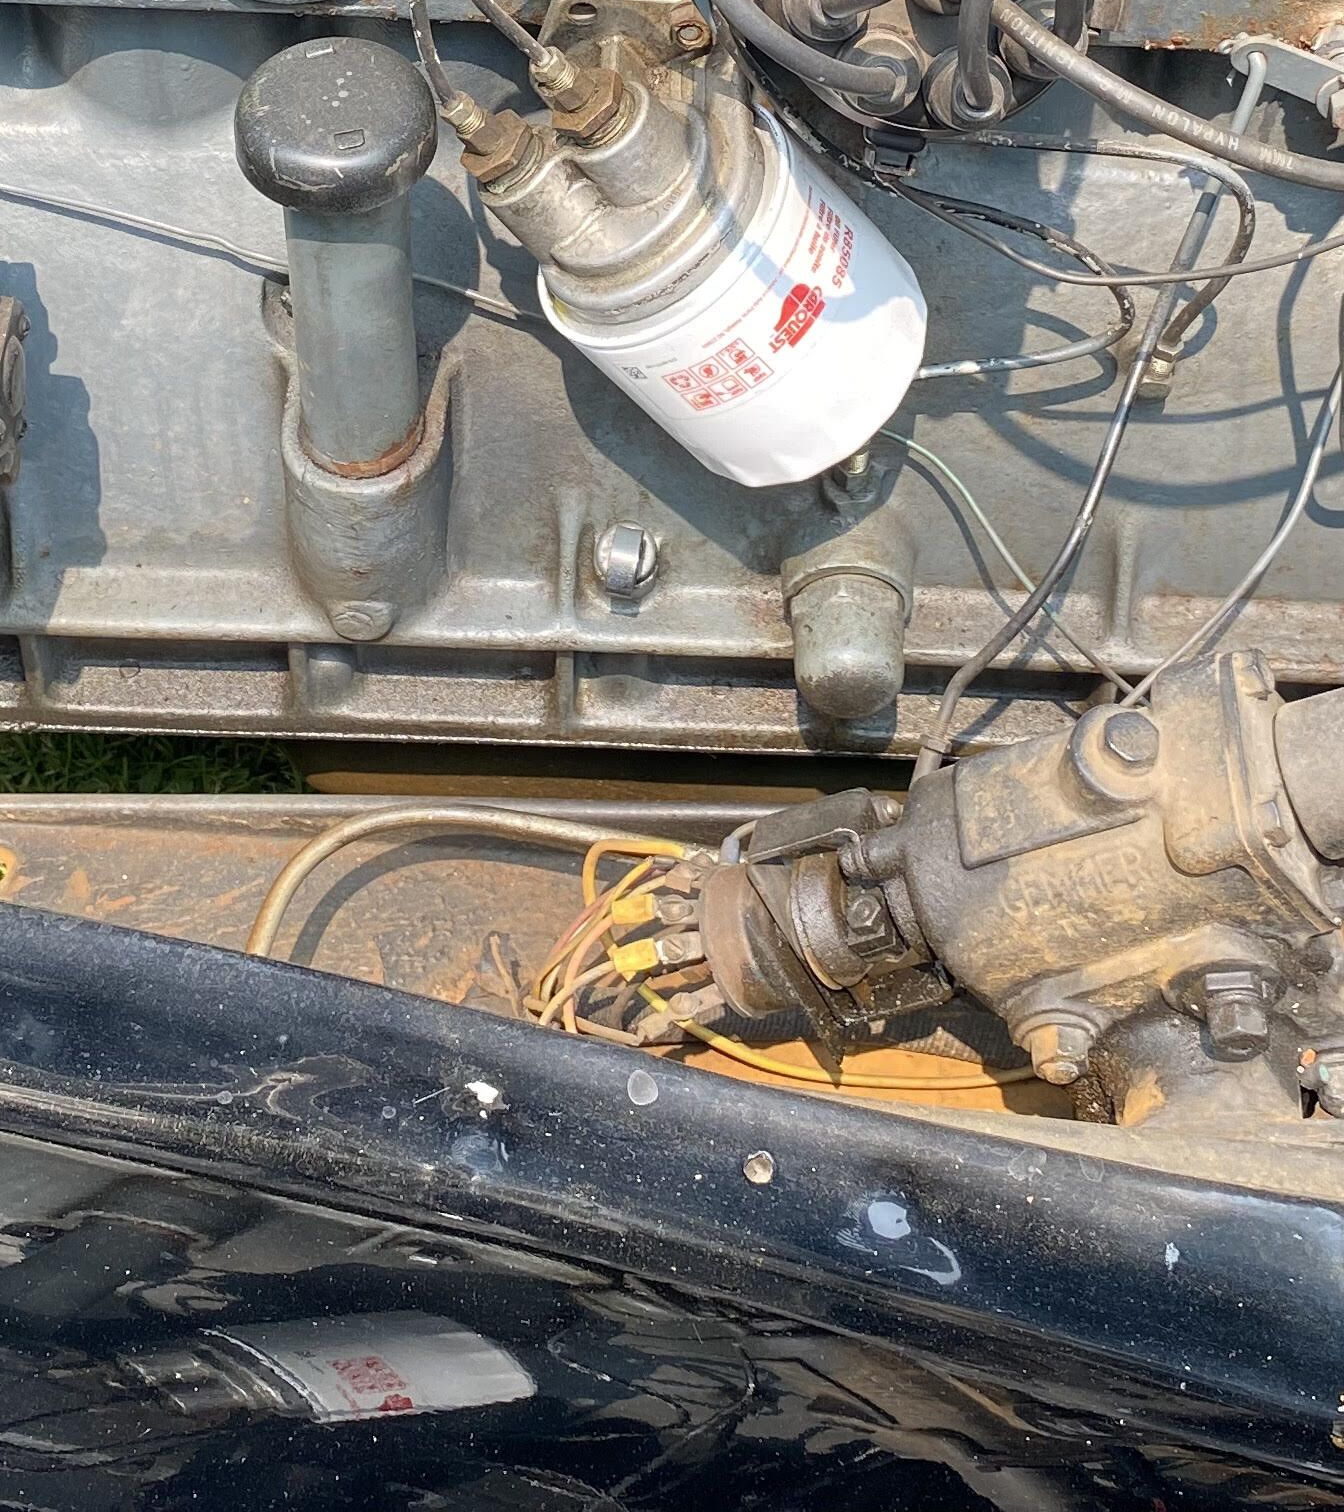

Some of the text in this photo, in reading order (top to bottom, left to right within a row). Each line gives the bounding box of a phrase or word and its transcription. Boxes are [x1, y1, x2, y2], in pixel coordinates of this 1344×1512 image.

[999, 6, 1075, 70] IGNITION
[1150, 103, 1240, 151] HYPALON
[768, 285, 822, 354] CARQUEST
